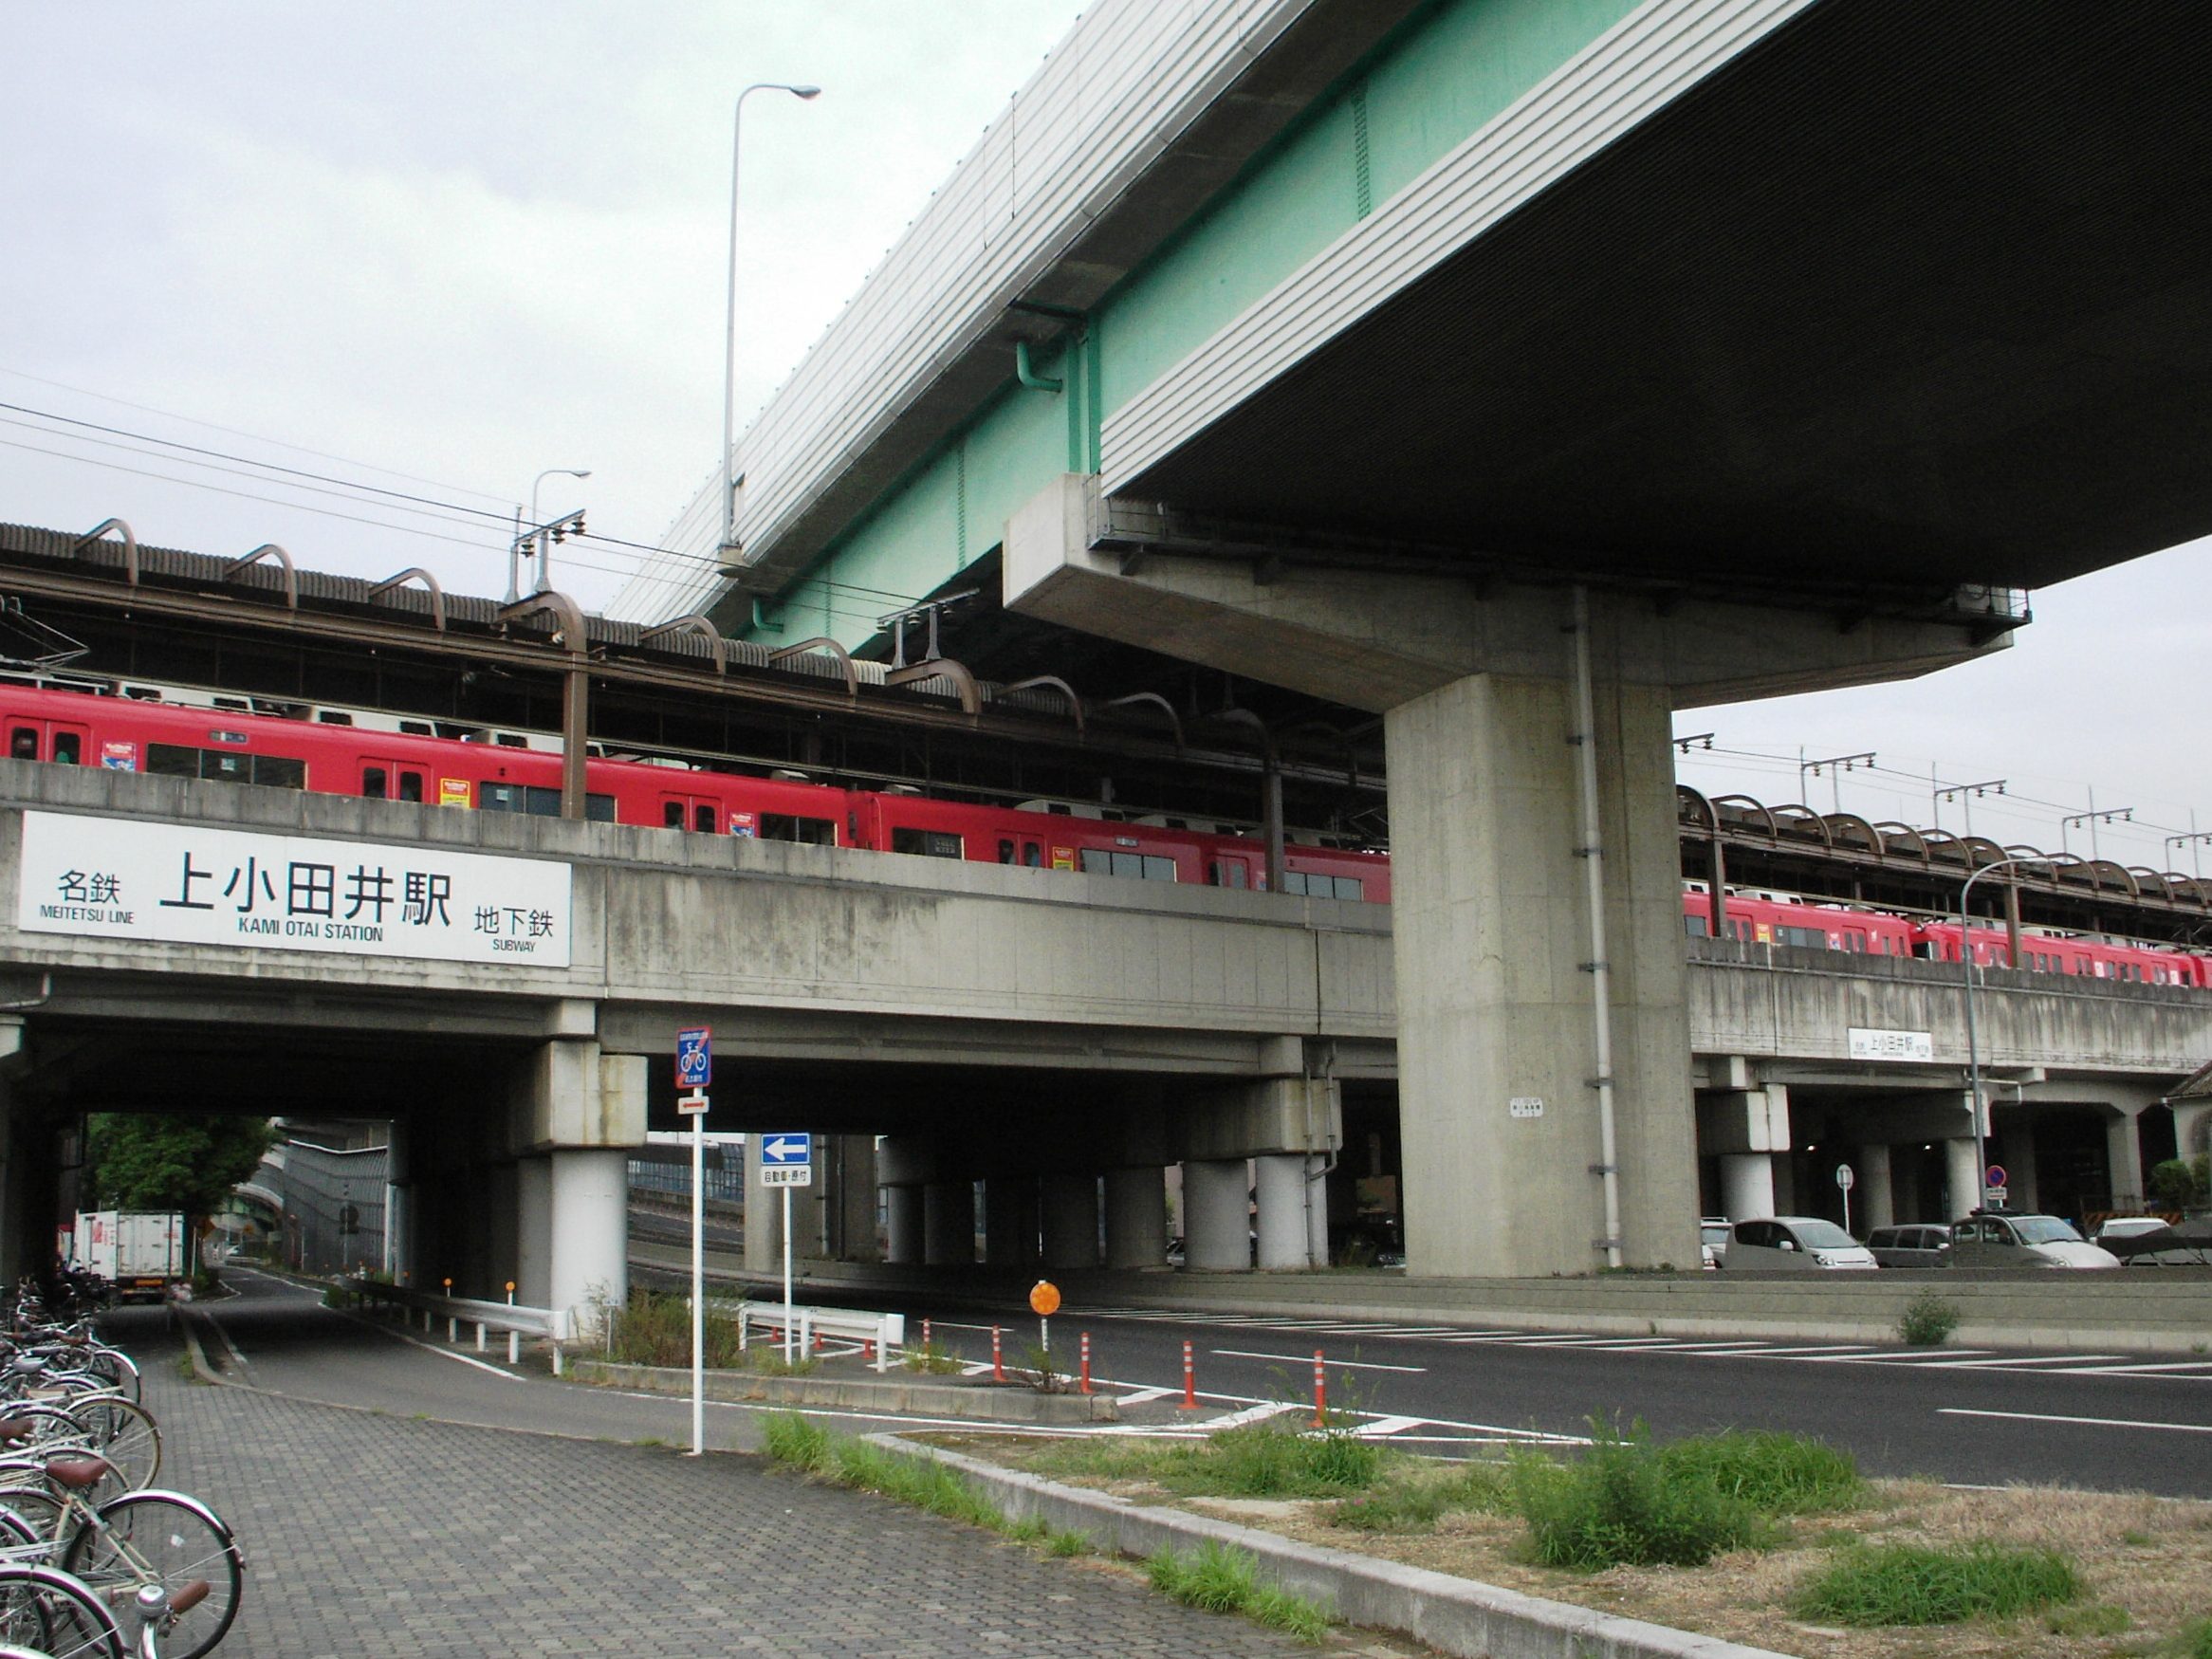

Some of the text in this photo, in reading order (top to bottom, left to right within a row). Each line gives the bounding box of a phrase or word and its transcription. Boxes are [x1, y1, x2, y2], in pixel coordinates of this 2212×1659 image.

[58, 869, 120, 904] 名鉄
[158, 851, 452, 928] 上小田井駅
[40, 904, 135, 925] MEITETSU LINE
[238, 916, 383, 942] KAMI OTAI STATION
[474, 905, 554, 938] 地下鉄
[492, 938, 537, 953] SUBWAY
